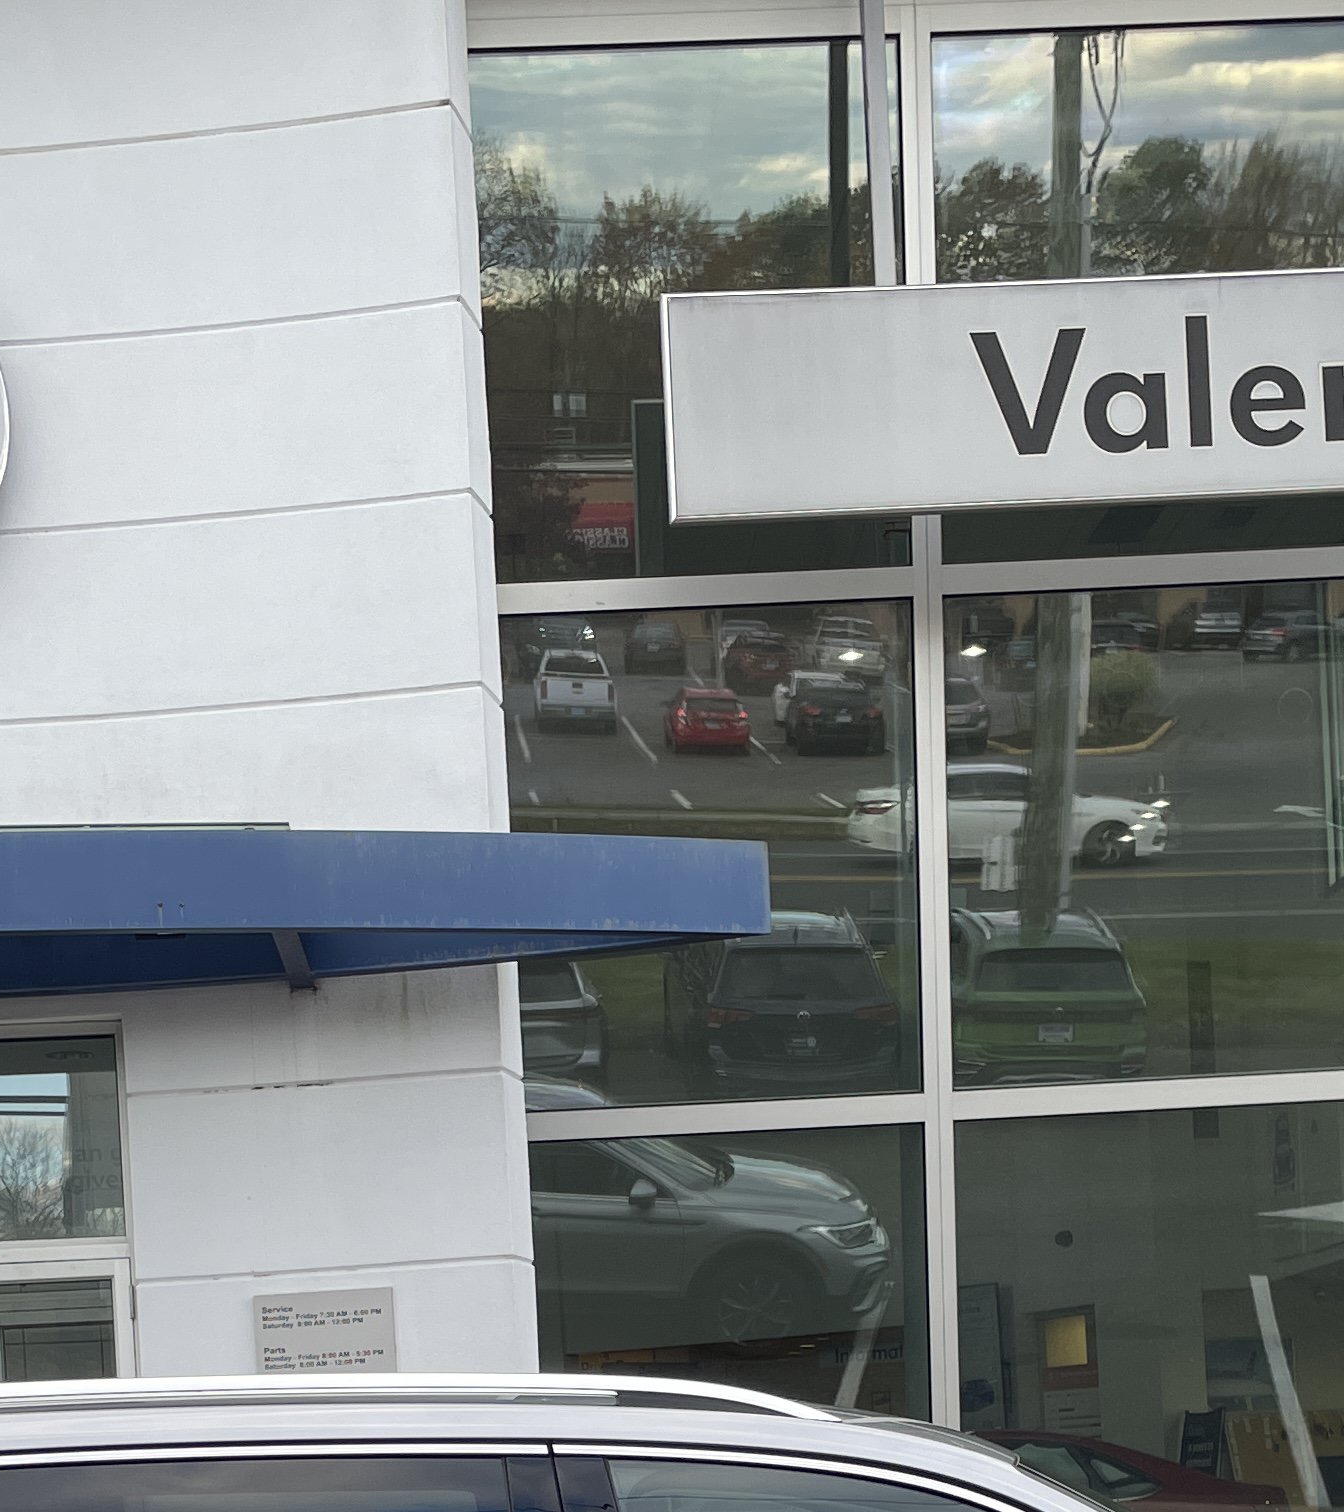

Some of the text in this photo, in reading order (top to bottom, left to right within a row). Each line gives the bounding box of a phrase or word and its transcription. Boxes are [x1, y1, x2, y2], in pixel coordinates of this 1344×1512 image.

[261, 1305, 293, 1314] Service
[262, 1314, 290, 1323] Monday
[295, 1312, 318, 1321] Friday
[262, 1321, 293, 1330] Saturday
[264, 1346, 286, 1355] Parts
[264, 1355, 292, 1363] Monday
[297, 1353, 320, 1361] Friday
[265, 1362, 296, 1371] Saturday
